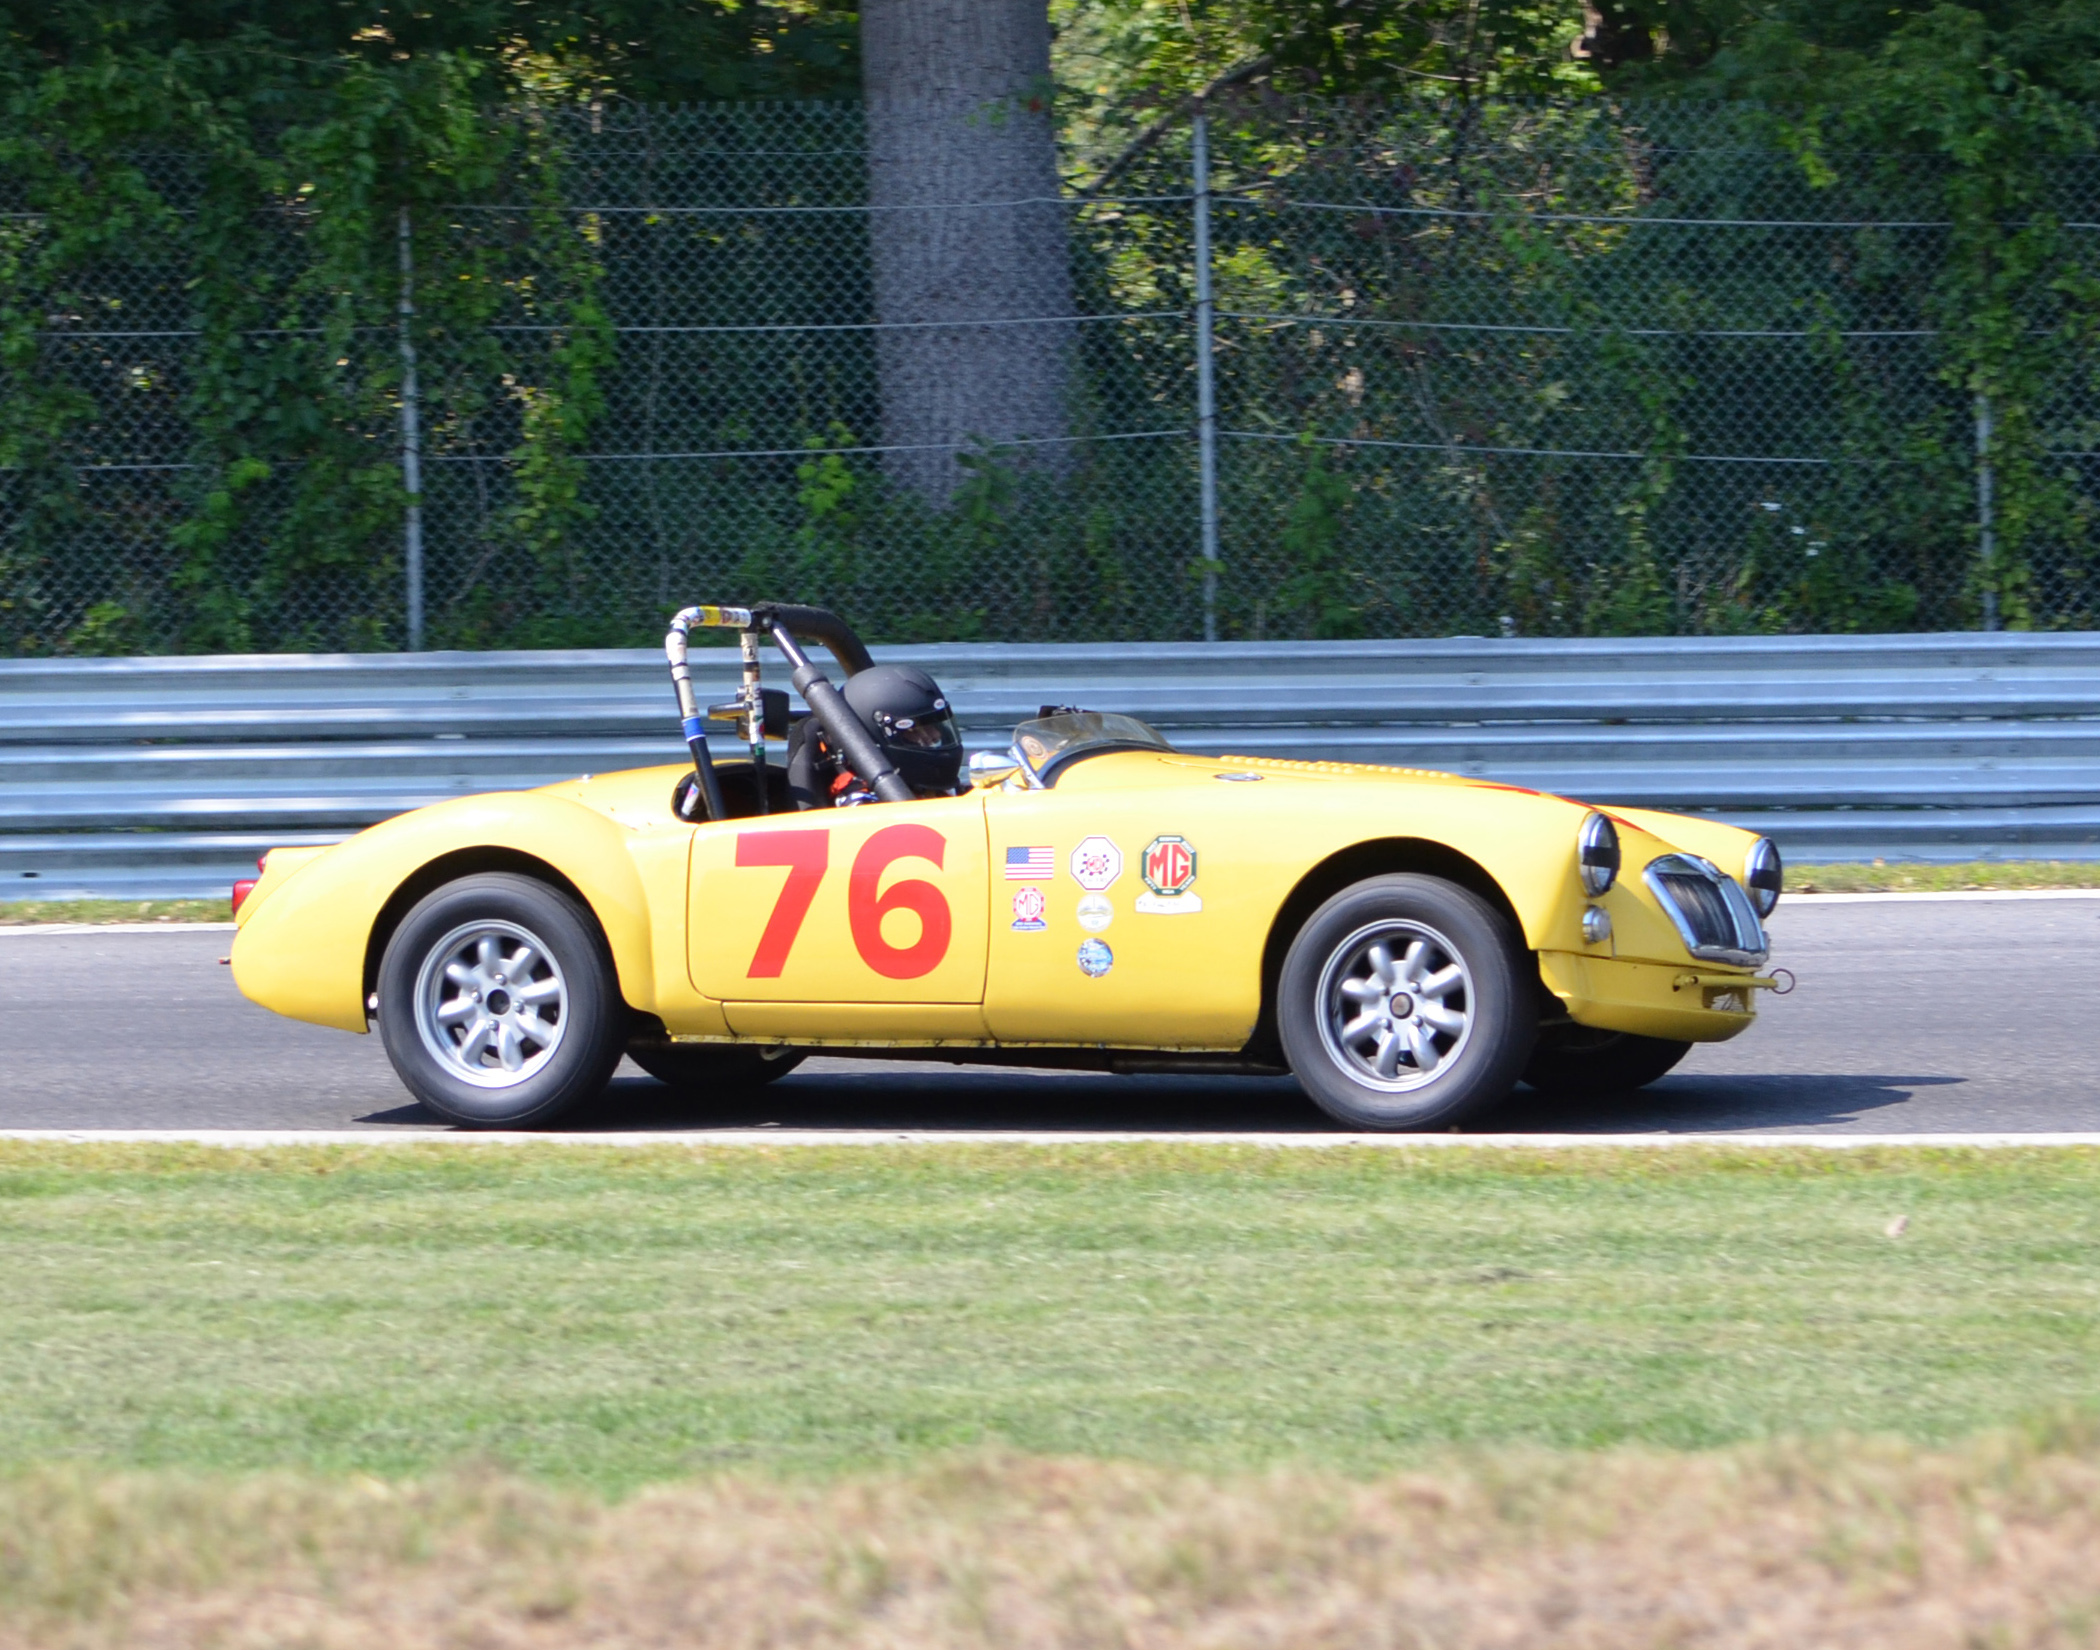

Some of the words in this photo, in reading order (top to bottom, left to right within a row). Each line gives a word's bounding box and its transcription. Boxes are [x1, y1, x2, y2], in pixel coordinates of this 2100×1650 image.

[1149, 844, 1189, 887] MG
[735, 823, 952, 980] 76
[1018, 893, 1039, 916] MG
